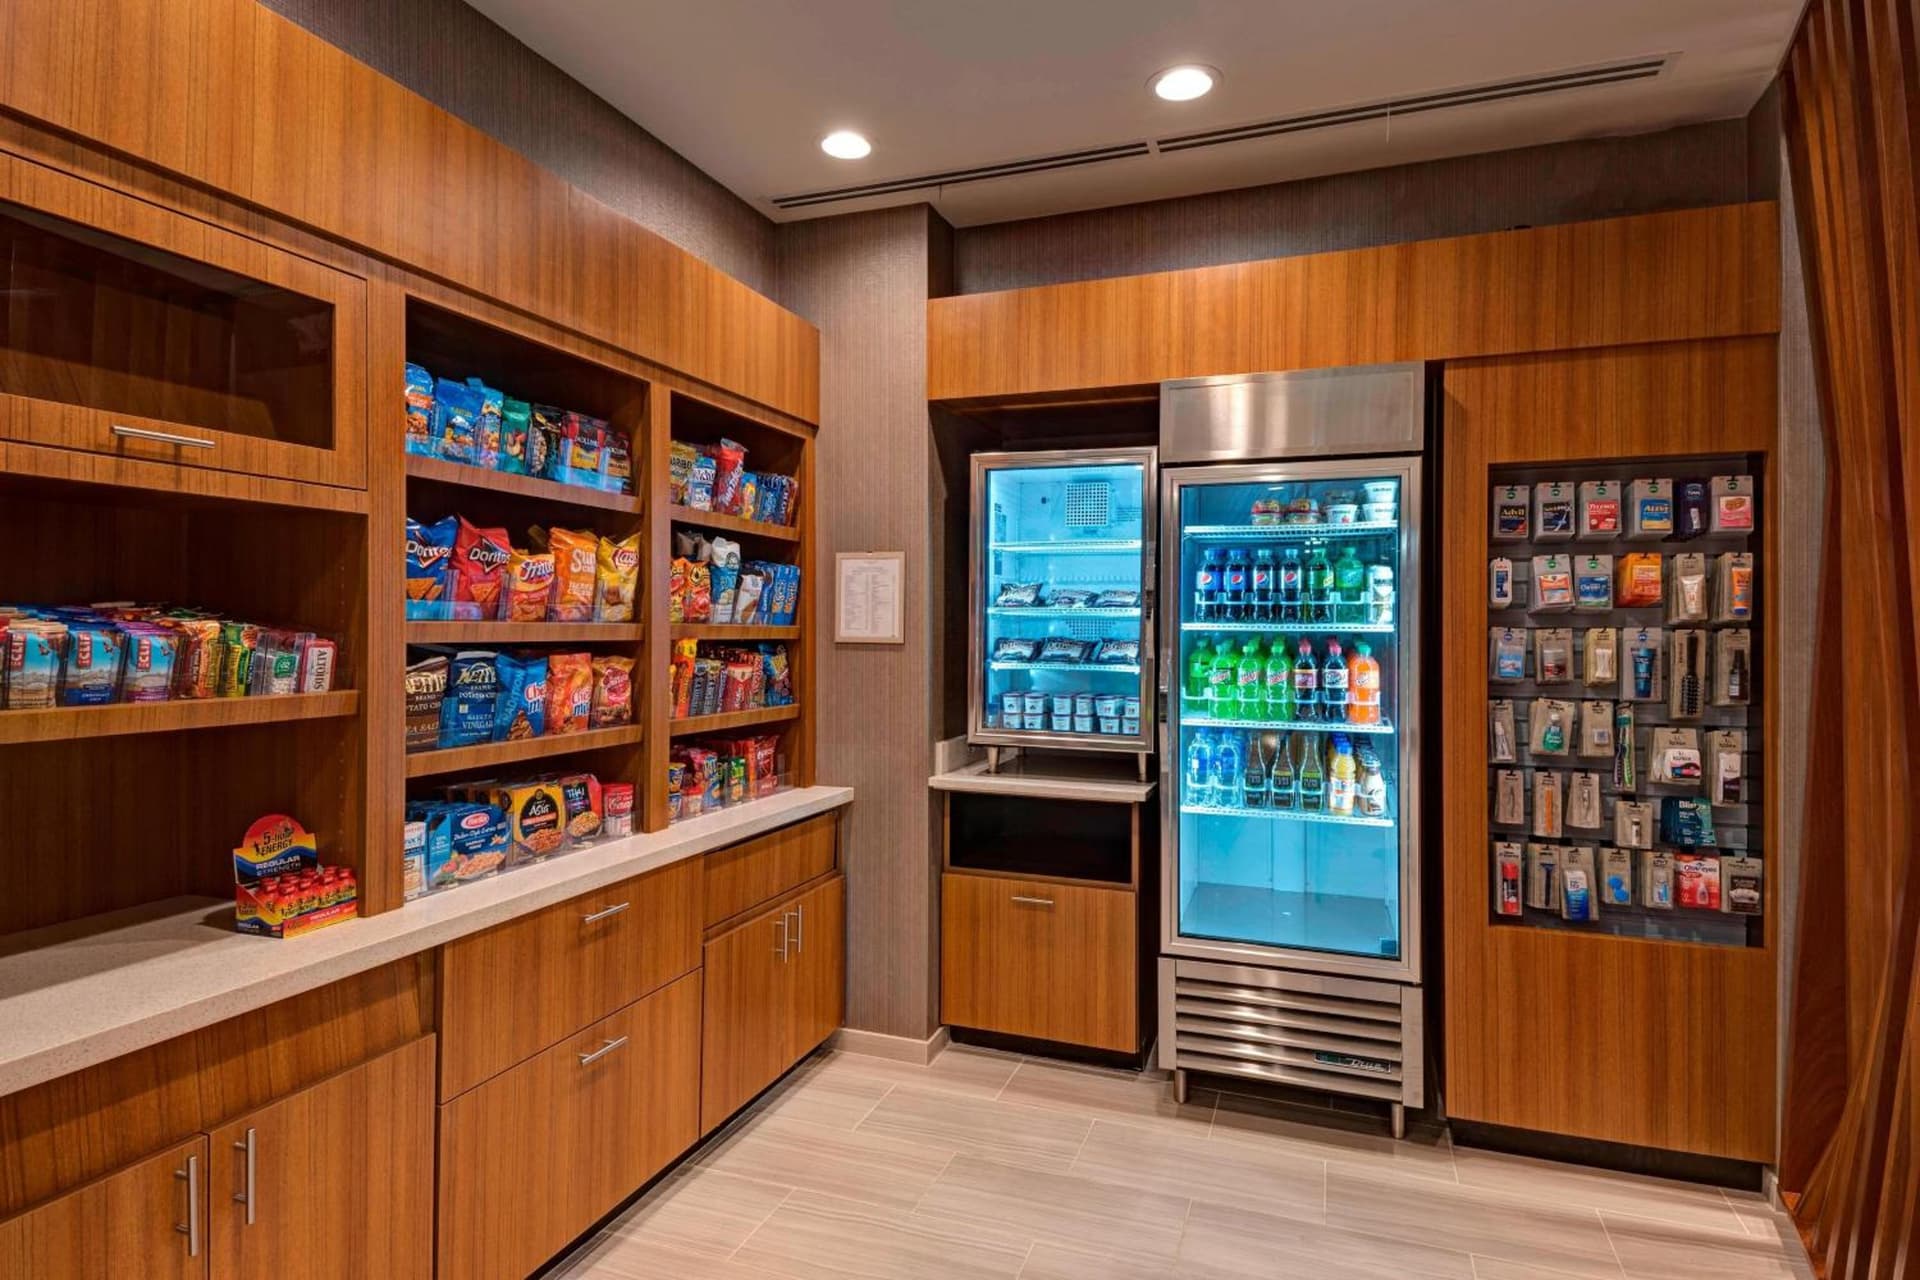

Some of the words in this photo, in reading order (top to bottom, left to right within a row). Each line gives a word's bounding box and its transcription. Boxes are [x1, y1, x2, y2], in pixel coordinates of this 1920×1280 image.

[1502, 508, 1525, 516] Advil
[406, 540, 452, 558] Doritos
[469, 547, 511, 564] Doritos
[313, 650, 328, 690] ALTOIDS
[261, 840, 292, 856] ENERGY
[256, 855, 300, 870] REGULAR
